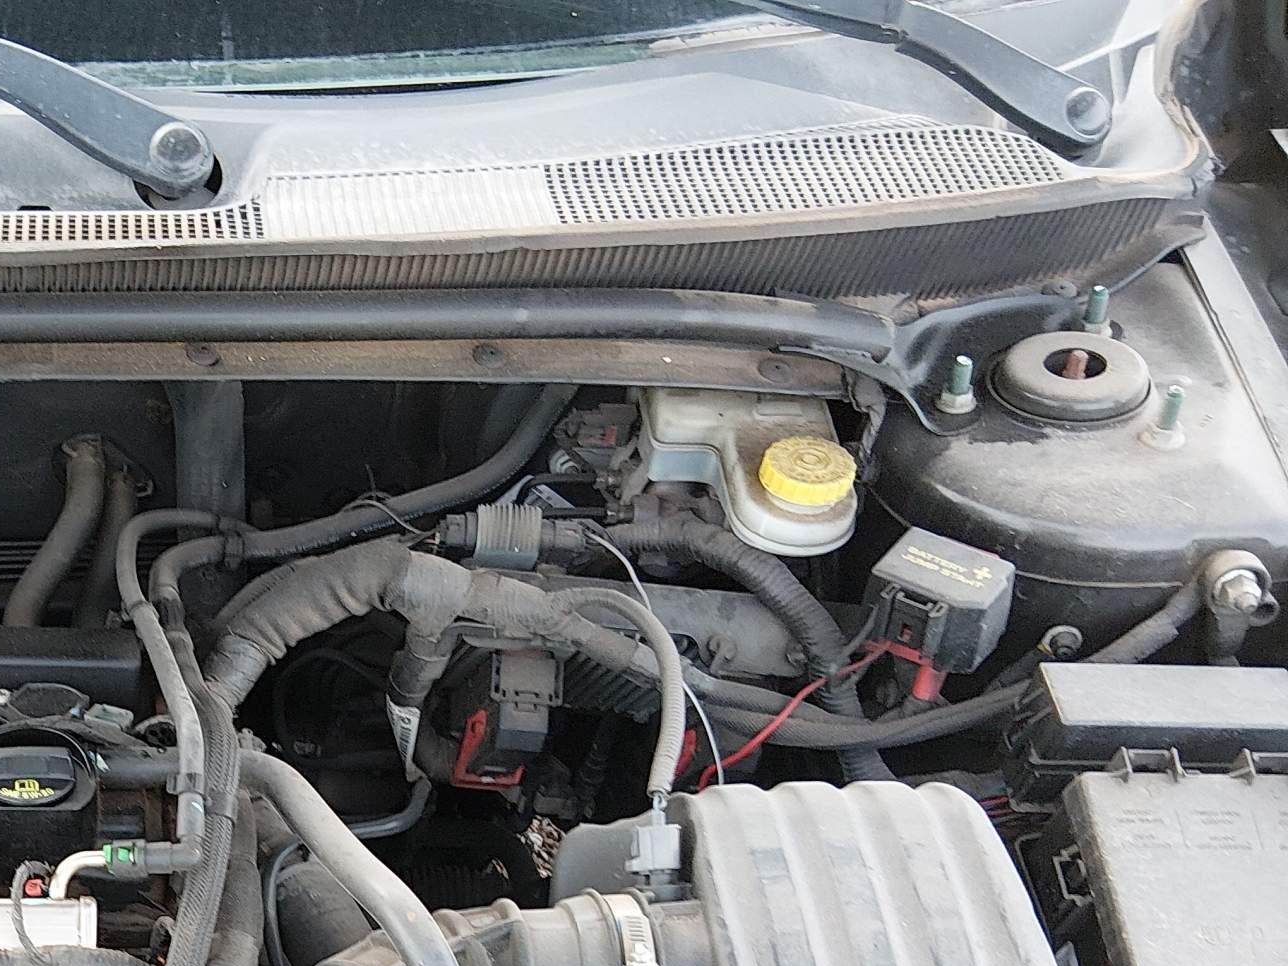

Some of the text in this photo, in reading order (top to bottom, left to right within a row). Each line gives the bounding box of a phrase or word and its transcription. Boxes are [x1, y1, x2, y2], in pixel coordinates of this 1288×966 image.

[900, 553, 986, 589] JUMP START
[906, 546, 969, 574] BATTERY
